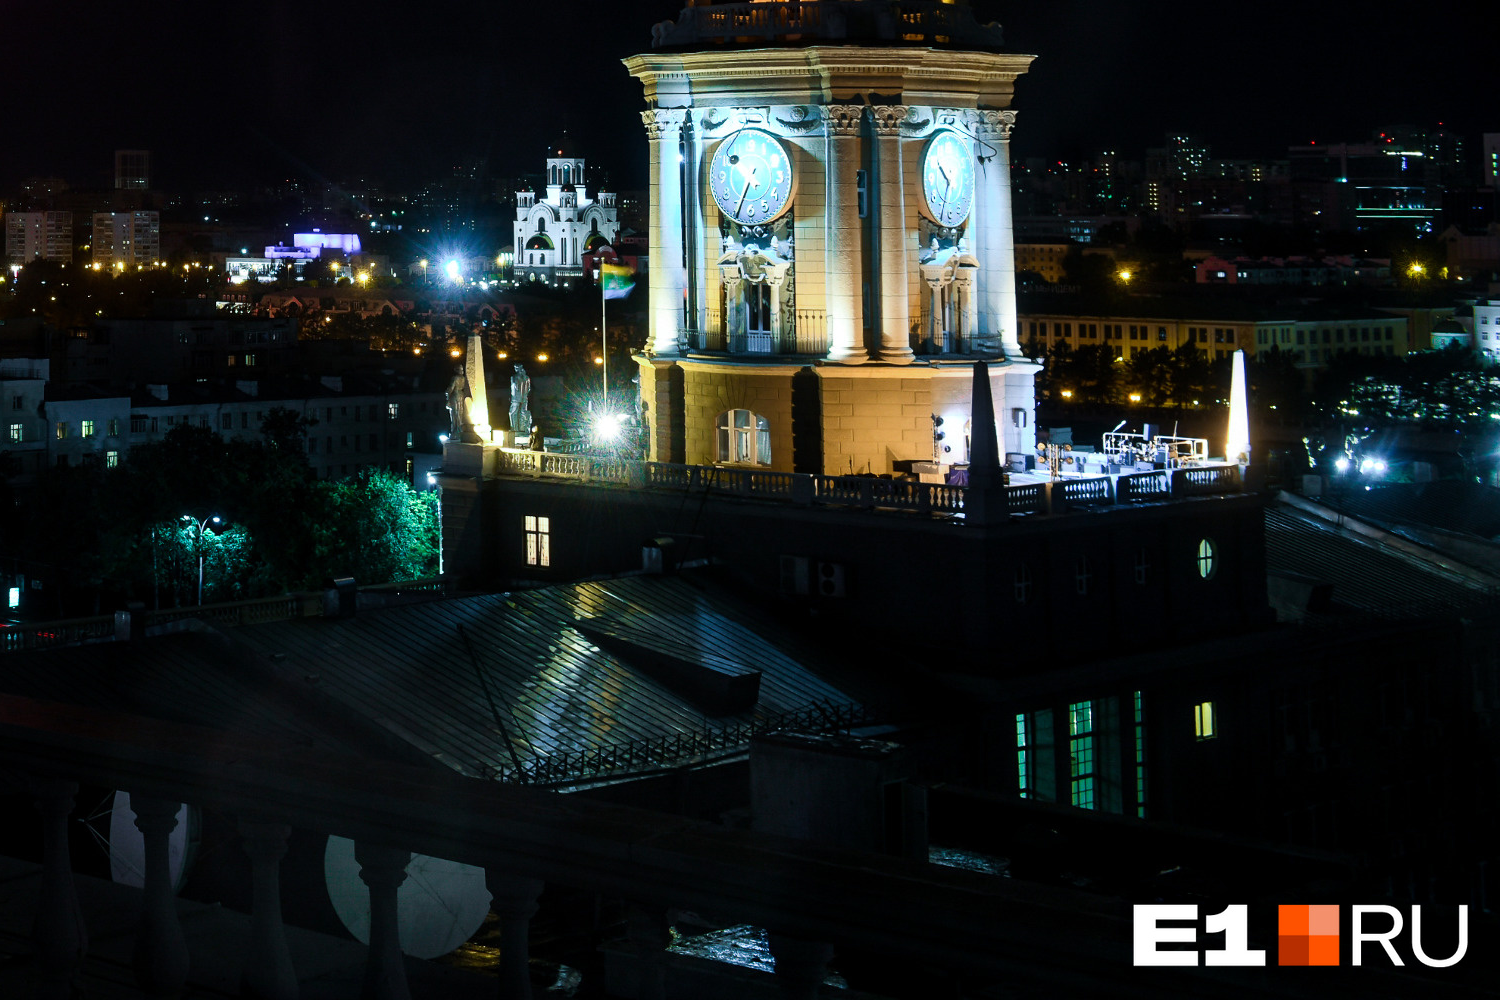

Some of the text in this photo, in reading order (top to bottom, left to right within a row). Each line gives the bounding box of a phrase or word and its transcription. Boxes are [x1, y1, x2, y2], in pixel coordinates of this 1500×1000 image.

[718, 170, 726, 184] 9
[776, 170, 784, 184] 3
[722, 187, 731, 201] 8
[770, 186, 779, 201] 4
[746, 204, 755, 217] 6
[761, 199, 769, 213] 5
